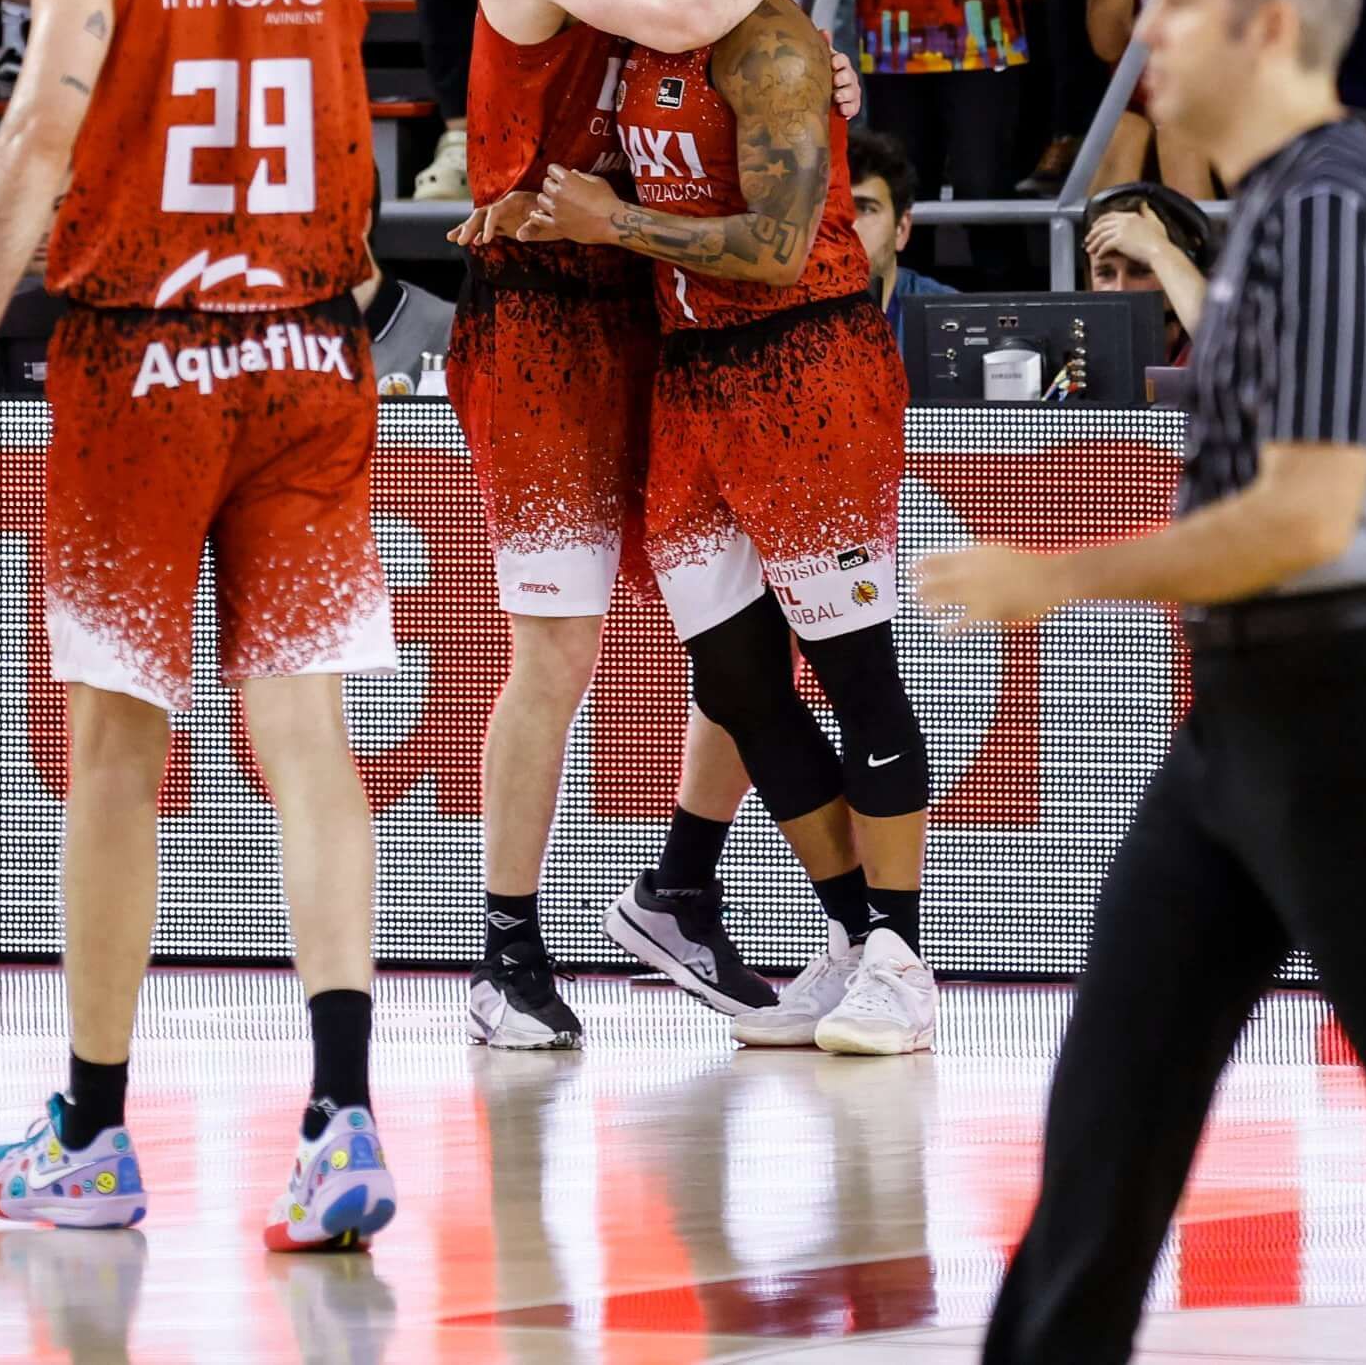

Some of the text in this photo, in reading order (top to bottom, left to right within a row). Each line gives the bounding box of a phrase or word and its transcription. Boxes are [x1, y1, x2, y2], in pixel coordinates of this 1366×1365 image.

[264, 11, 324, 26] AVINENT
[161, 58, 316, 214] 29
[131, 321, 355, 398] Aquaflix
[841, 554, 865, 571] acb
